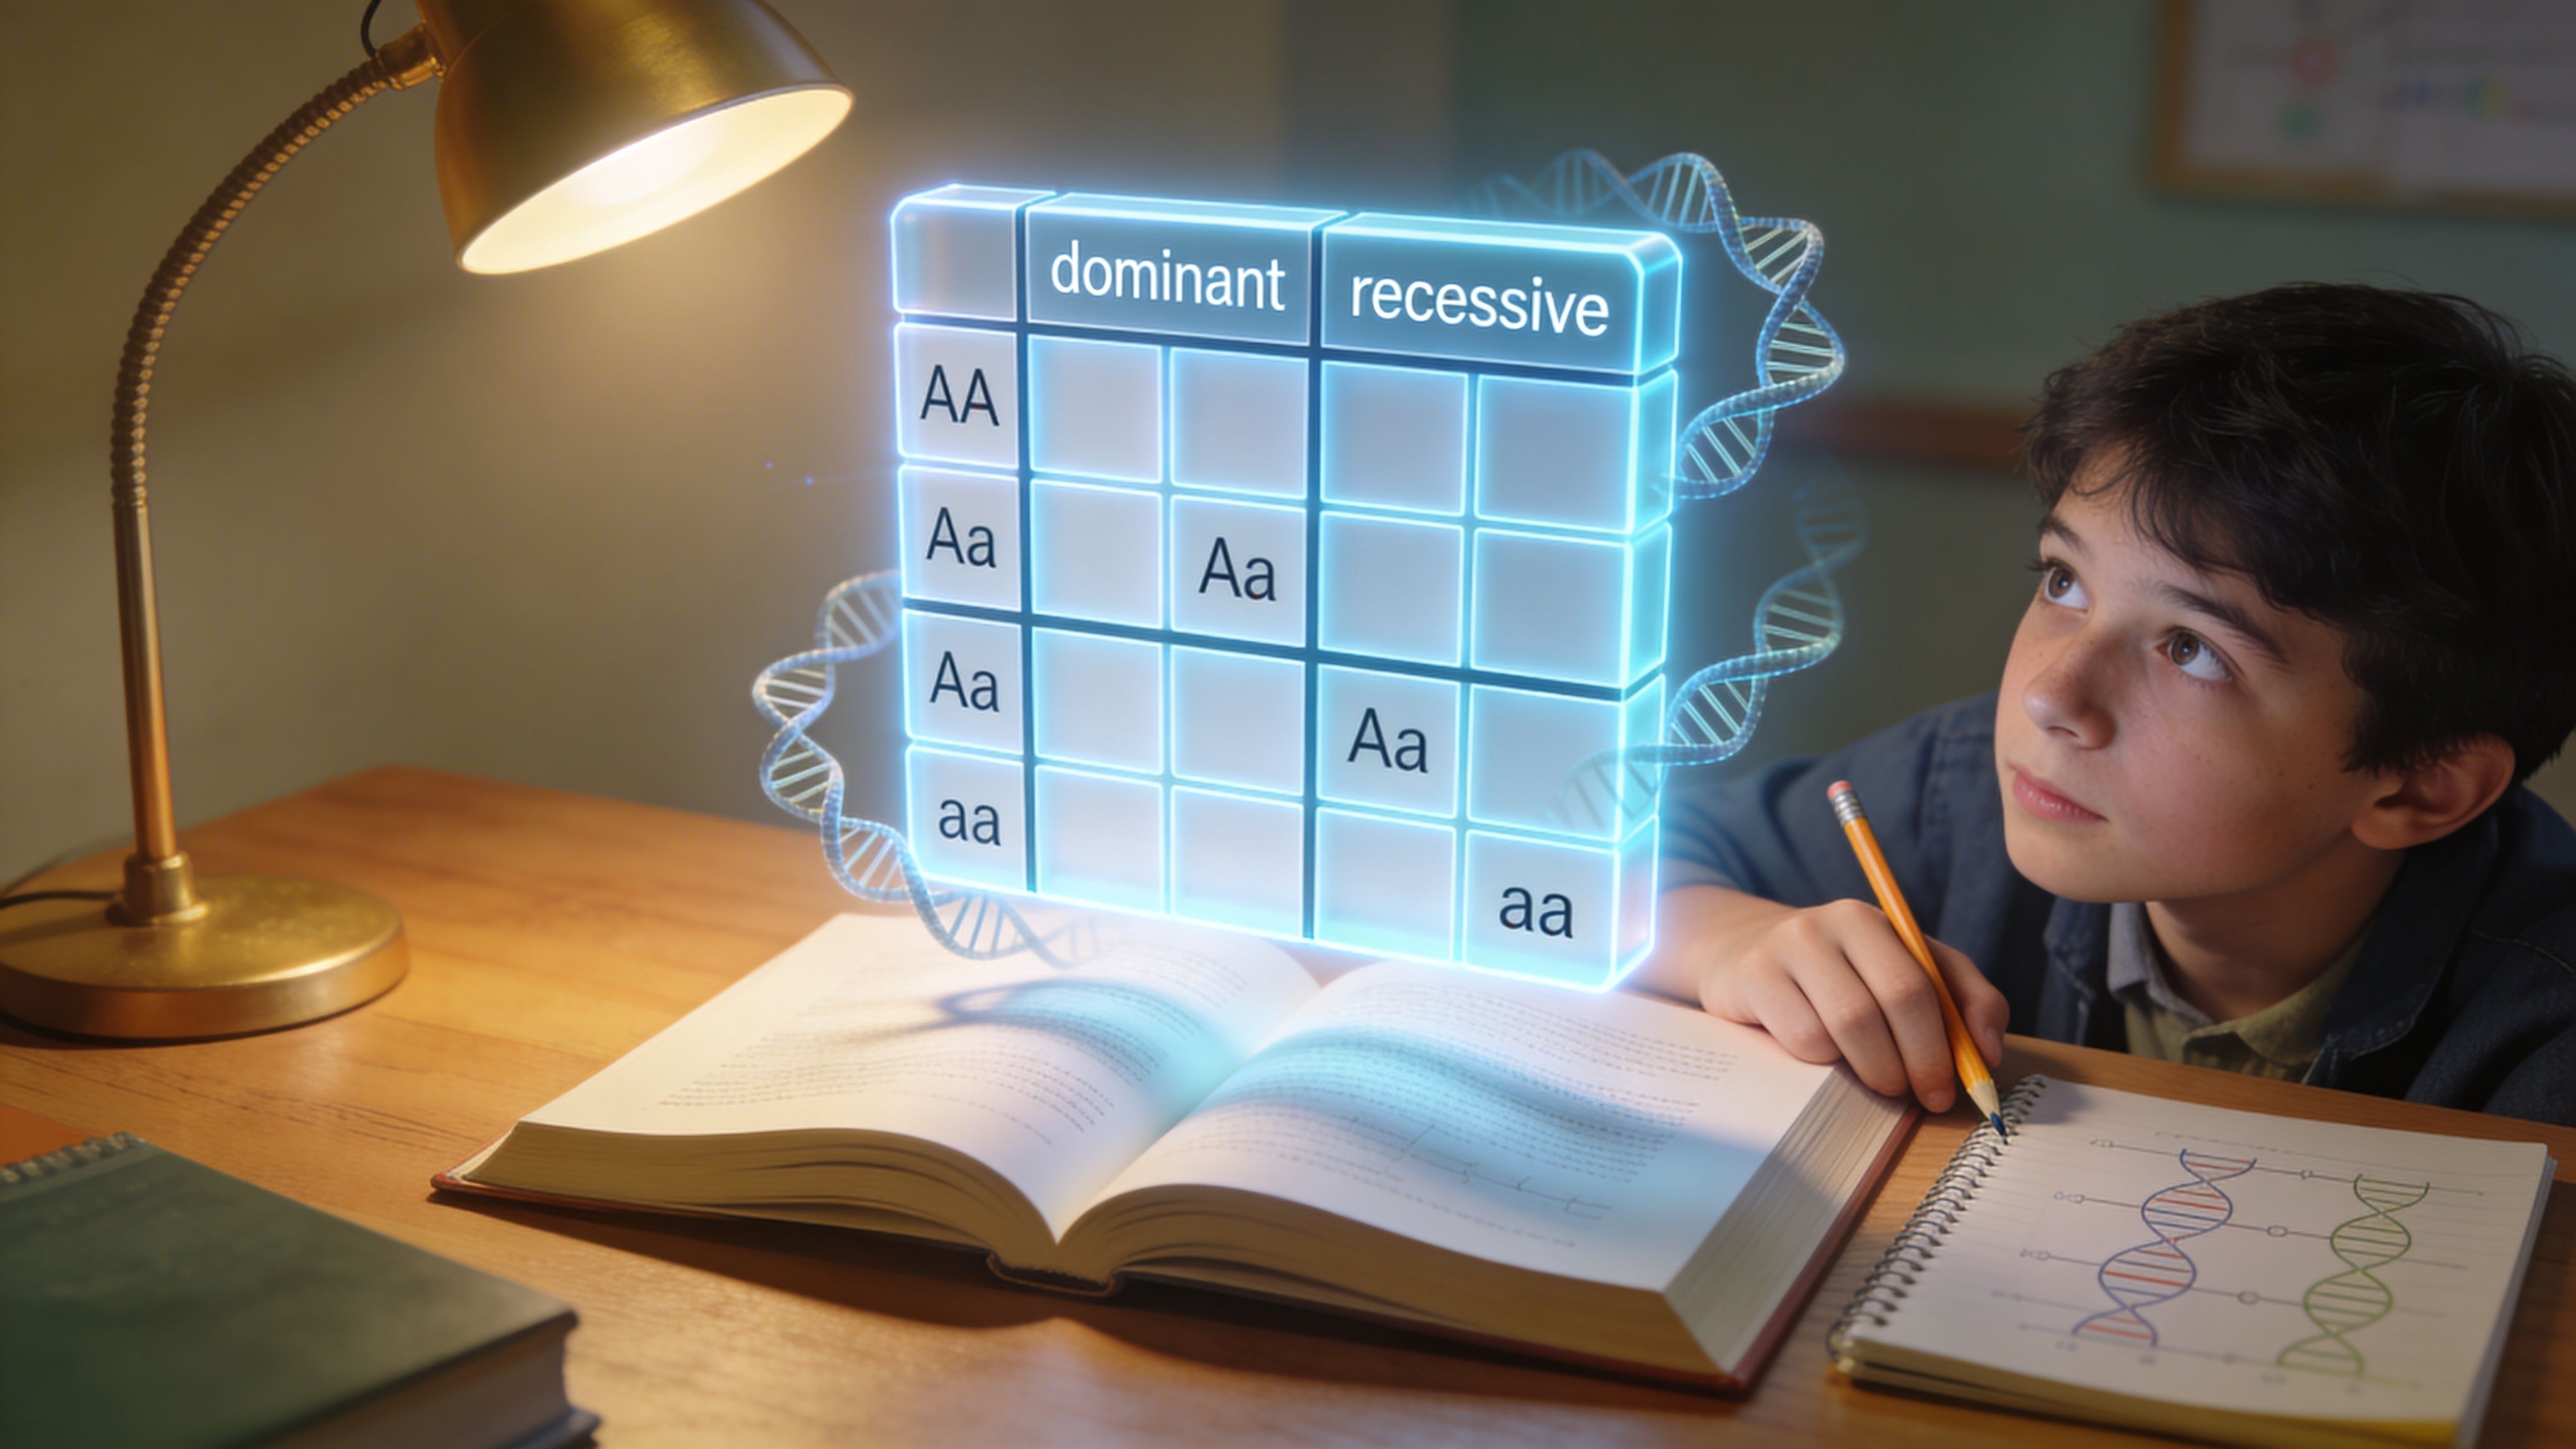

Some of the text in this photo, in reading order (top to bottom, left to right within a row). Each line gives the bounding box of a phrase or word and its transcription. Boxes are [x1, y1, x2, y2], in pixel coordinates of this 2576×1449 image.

[1050, 239, 1285, 311] dominant
[1352, 274, 1610, 336] recessive
[919, 364, 1000, 427] AA
[926, 506, 997, 569] Aa
[1198, 536, 1277, 602] Aa
[929, 650, 1000, 713] Aa
[1346, 707, 1428, 774] Aa
[938, 799, 1001, 847] aa
[1499, 886, 1574, 940] aa
